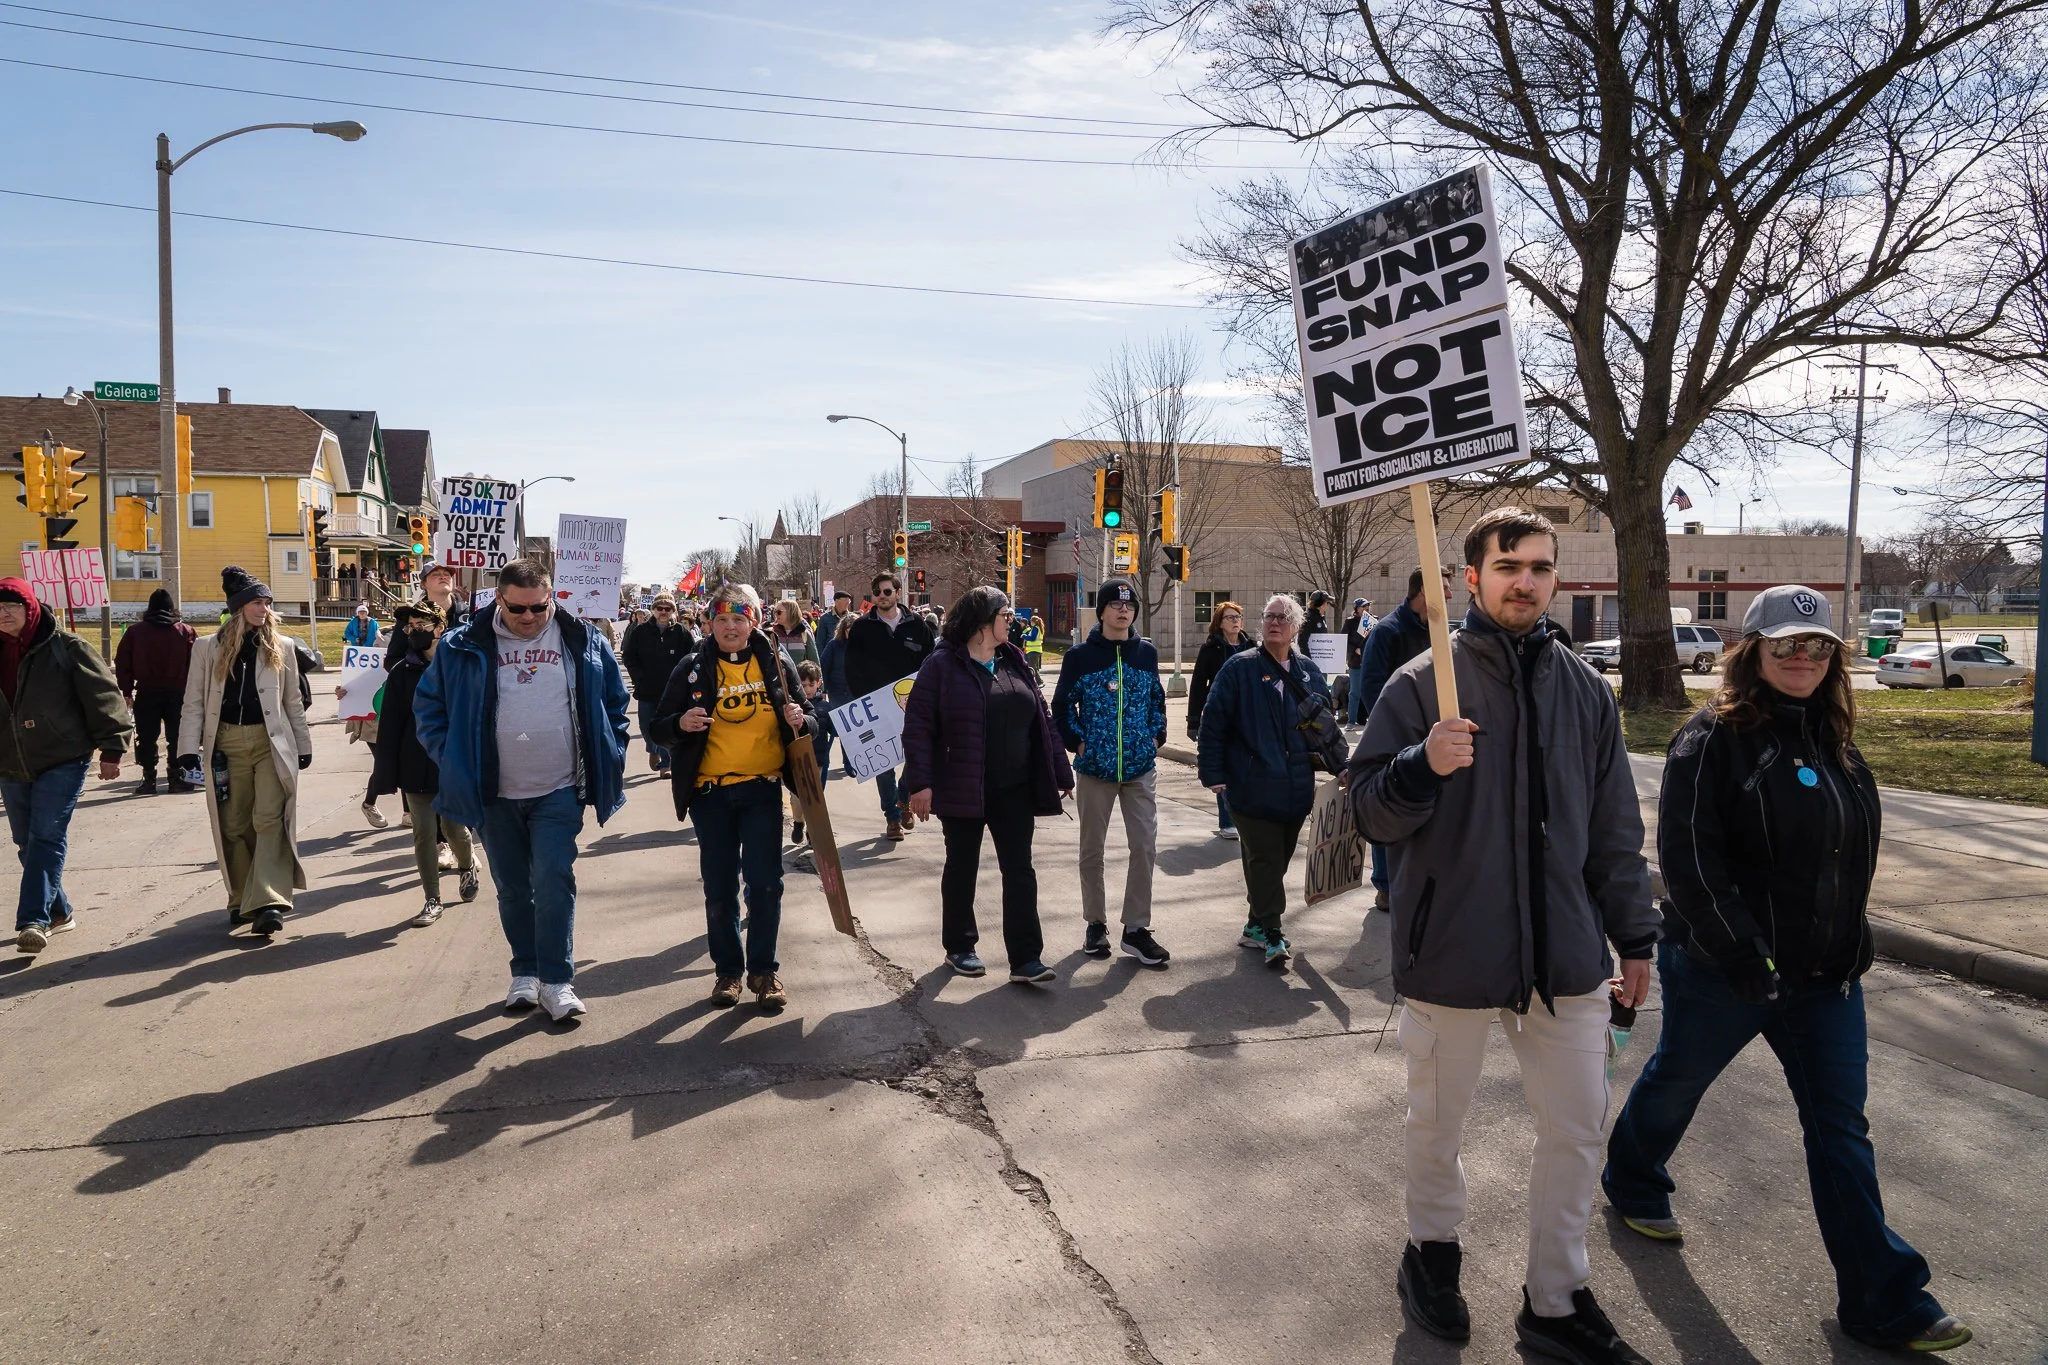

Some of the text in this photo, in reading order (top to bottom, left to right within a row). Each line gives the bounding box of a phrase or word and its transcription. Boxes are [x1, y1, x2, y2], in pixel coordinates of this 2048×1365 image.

[1301, 222, 1487, 319] FUND
[1306, 261, 1490, 352] SNAP
[1312, 320, 1502, 417] NOT
[96, 386, 102, 394] W
[104, 384, 147, 398] Galena
[1334, 375, 1494, 464] ICE
[1327, 431, 1513, 492] PARTY FOR SOCIALISM & LIBERATION
[442, 477, 517, 500] IT'S OK TO
[450, 497, 507, 517] ADMIT
[443, 513, 506, 534] YOU'VE
[453, 532, 500, 551] BEEN
[579, 542, 599, 550] are
[21, 549, 104, 580] FUCK ICE
[446, 548, 508, 568] LIED TO
[556, 549, 621, 563] HUMAN BEINGS
[70, 580, 105, 607] OUT
[476, 590, 497, 601] TRU
[920, 582, 925, 590] 4
[345, 648, 386, 668] Res
[498, 649, 562, 667] ALL STATE
[838, 696, 879, 732] ICE
[1316, 798, 1336, 847] NO
[1308, 831, 1363, 896] NO KINGS
